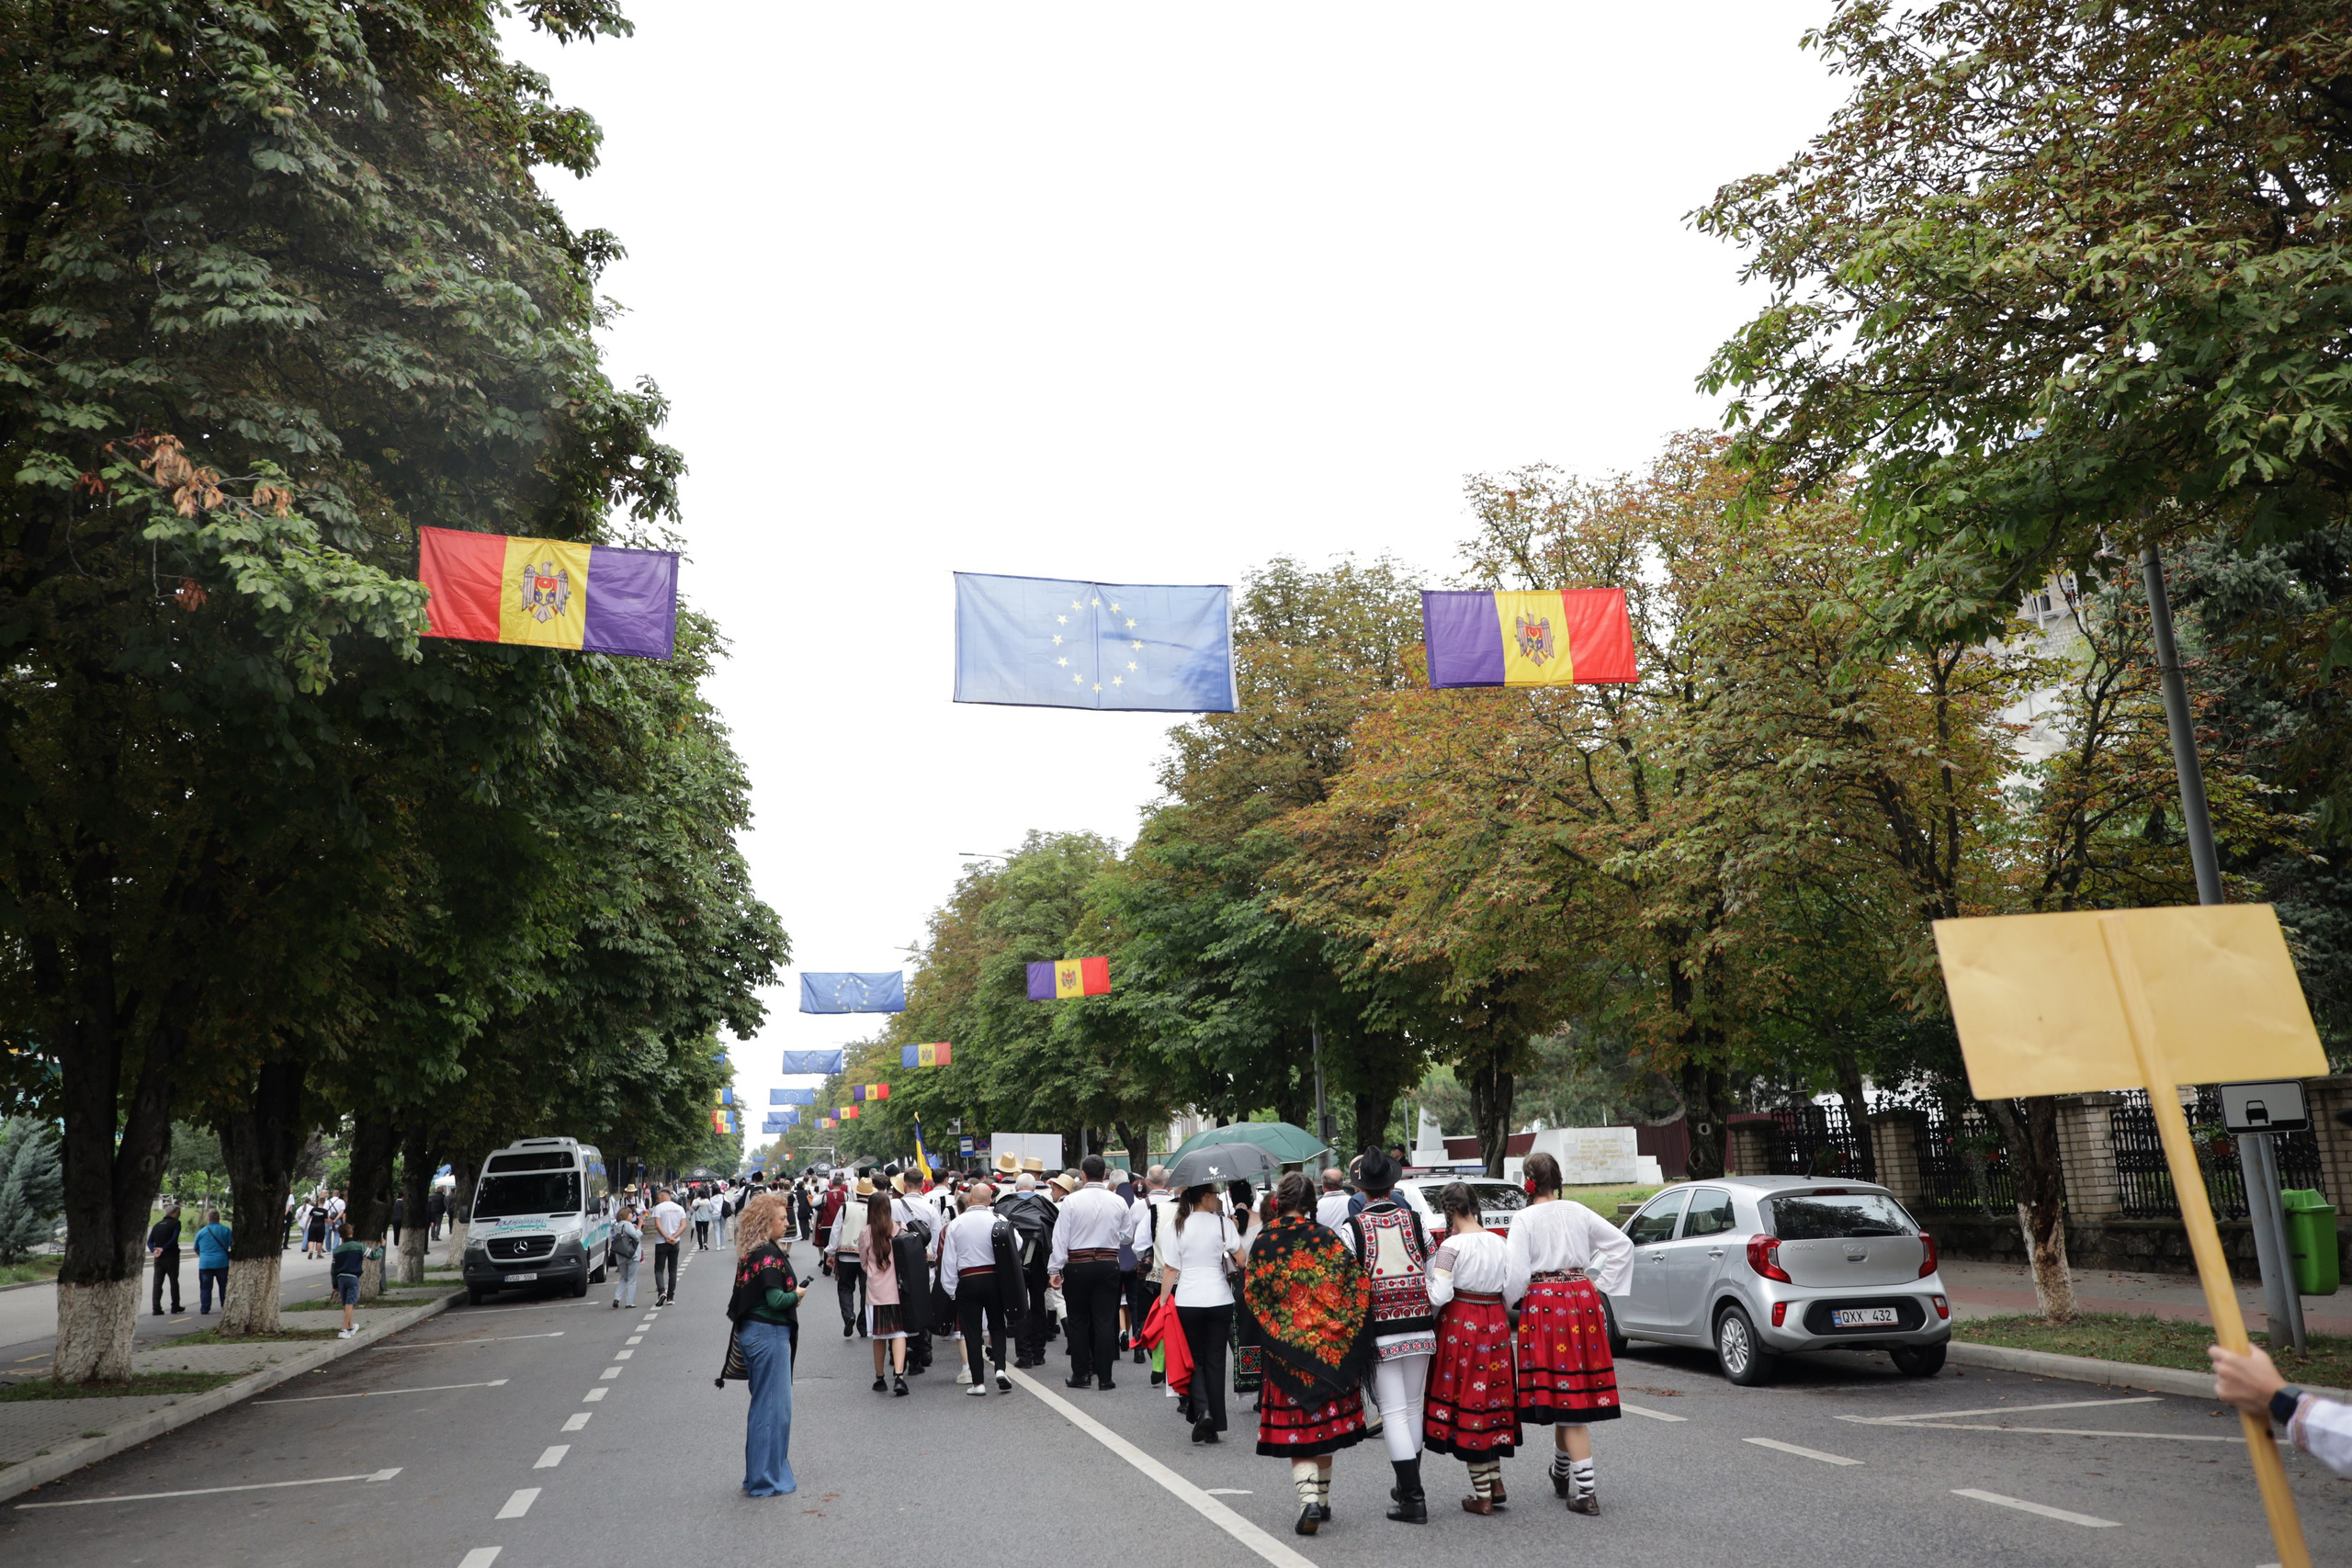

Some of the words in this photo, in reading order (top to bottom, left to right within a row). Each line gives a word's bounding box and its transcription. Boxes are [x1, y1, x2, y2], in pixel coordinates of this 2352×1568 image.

[1485, 1216, 1510, 1225] RAB
[1842, 1311, 1864, 1323] QXX
[1872, 1309, 1893, 1322] 432
